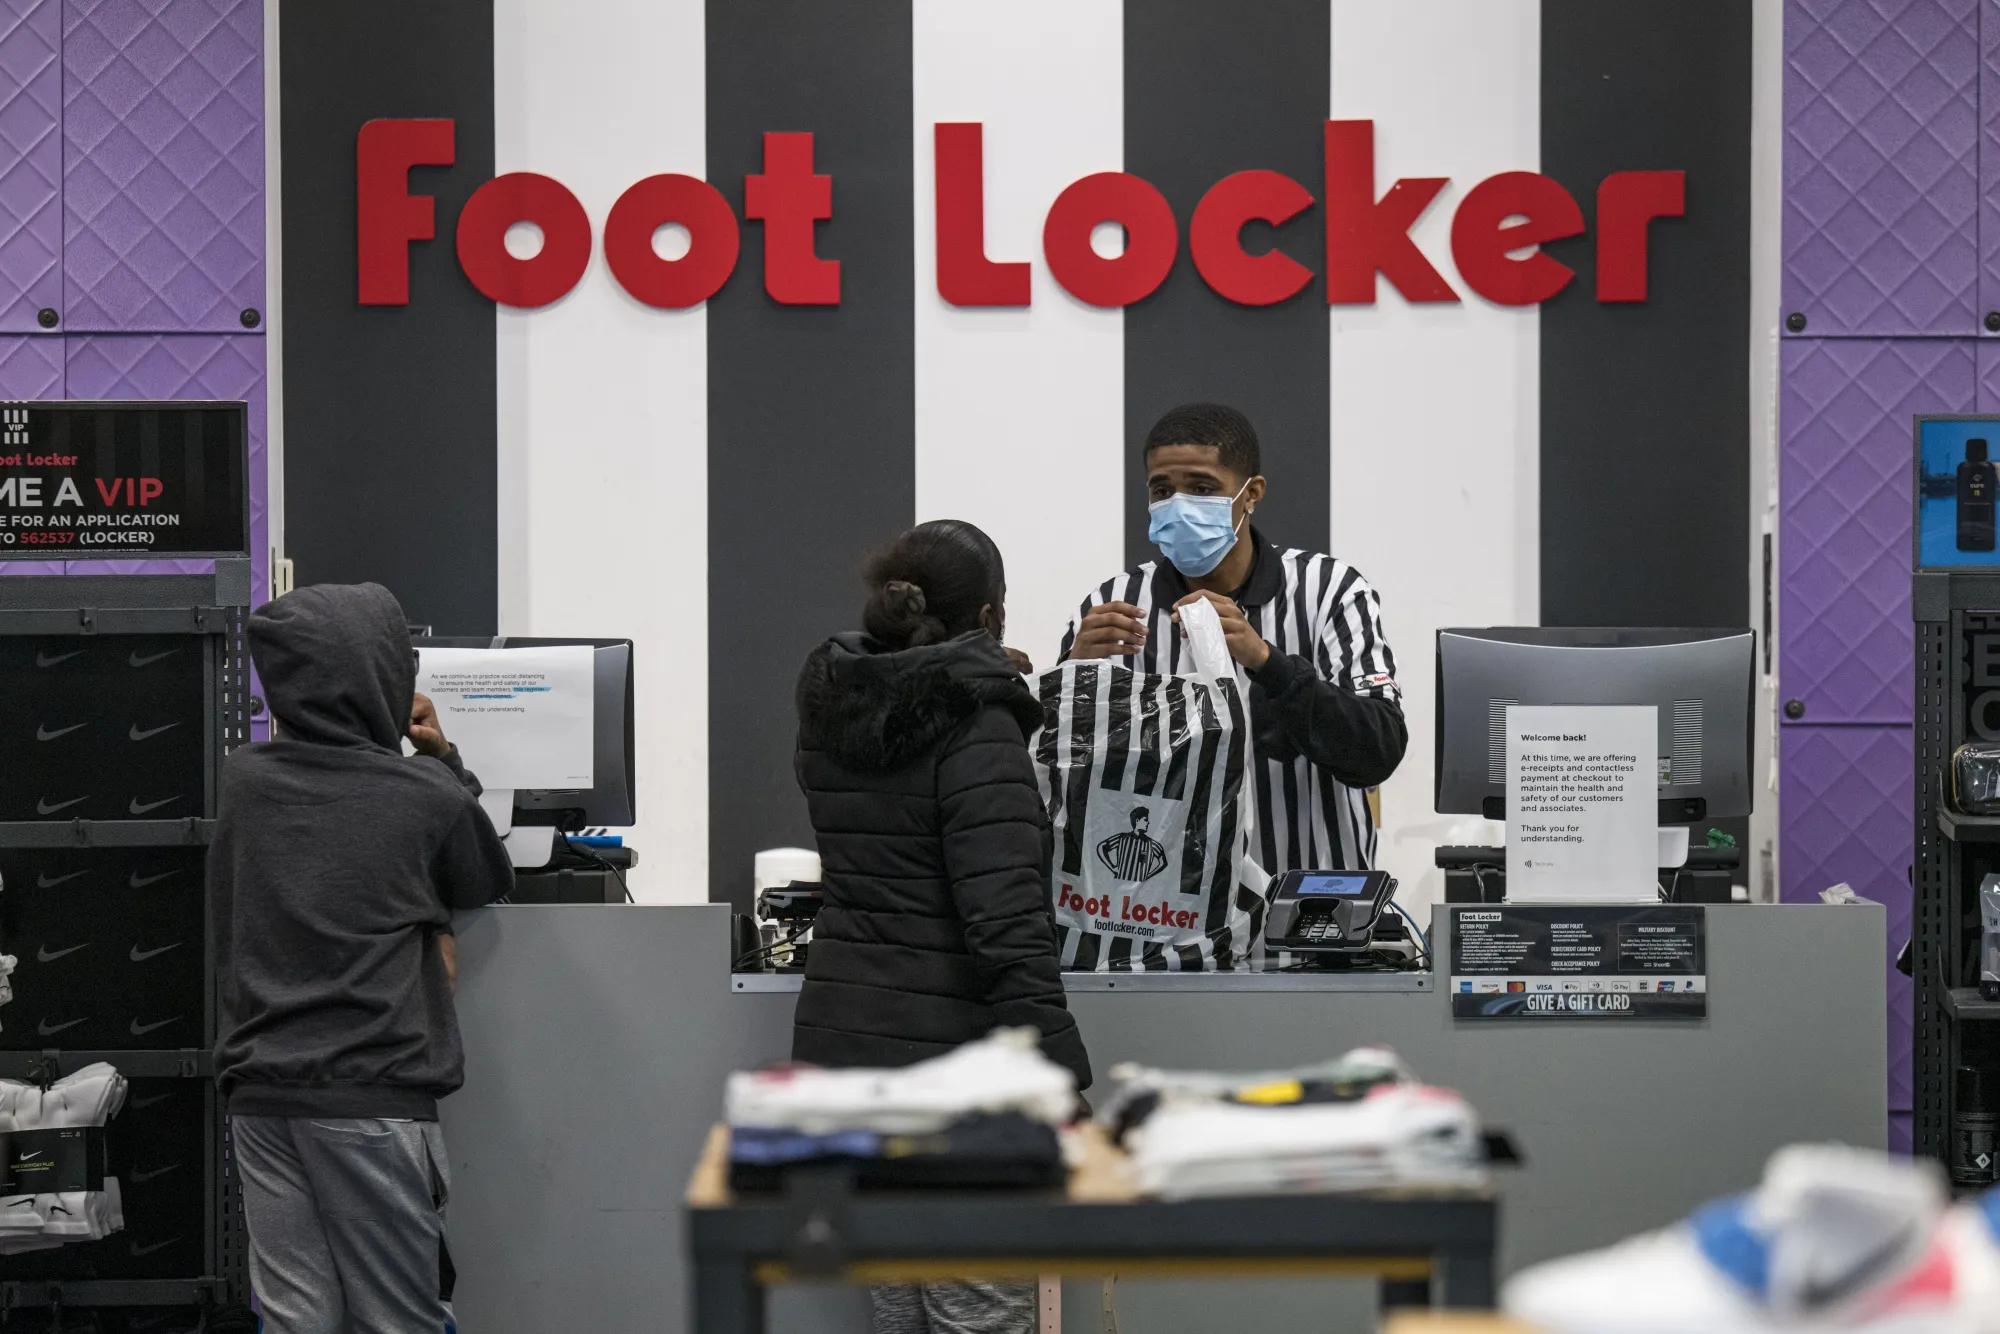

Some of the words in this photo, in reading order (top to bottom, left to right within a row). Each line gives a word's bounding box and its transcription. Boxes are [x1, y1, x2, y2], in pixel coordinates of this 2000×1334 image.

[357, 118, 841, 308] Foot
[934, 119, 1686, 307] Locker
[0, 453, 22, 466] oot
[26, 452, 78, 466] Locker
[0, 477, 43, 507] ME
[53, 477, 84, 507] A
[95, 477, 163, 507] VIP
[12, 516, 43, 526] FOR
[48, 516, 71, 526] AN
[76, 515, 179, 526] APPLICATION
[20, 532, 74, 544] 562537
[80, 532, 154, 544] (LOCKER)
[1521, 765, 1564, 773] e-receipts
[1521, 775, 1558, 783] payment
[1521, 835, 1584, 843] understanding.
[1058, 883, 1110, 918] Foot
[1122, 896, 1199, 929] Locker
[1094, 919, 1154, 937] footlocker.com
[1527, 995, 1554, 1010] GIVE
[1557, 995, 1565, 1010] A
[1568, 994, 1594, 1010] GIFT
[1598, 994, 1629, 1010] CARD
